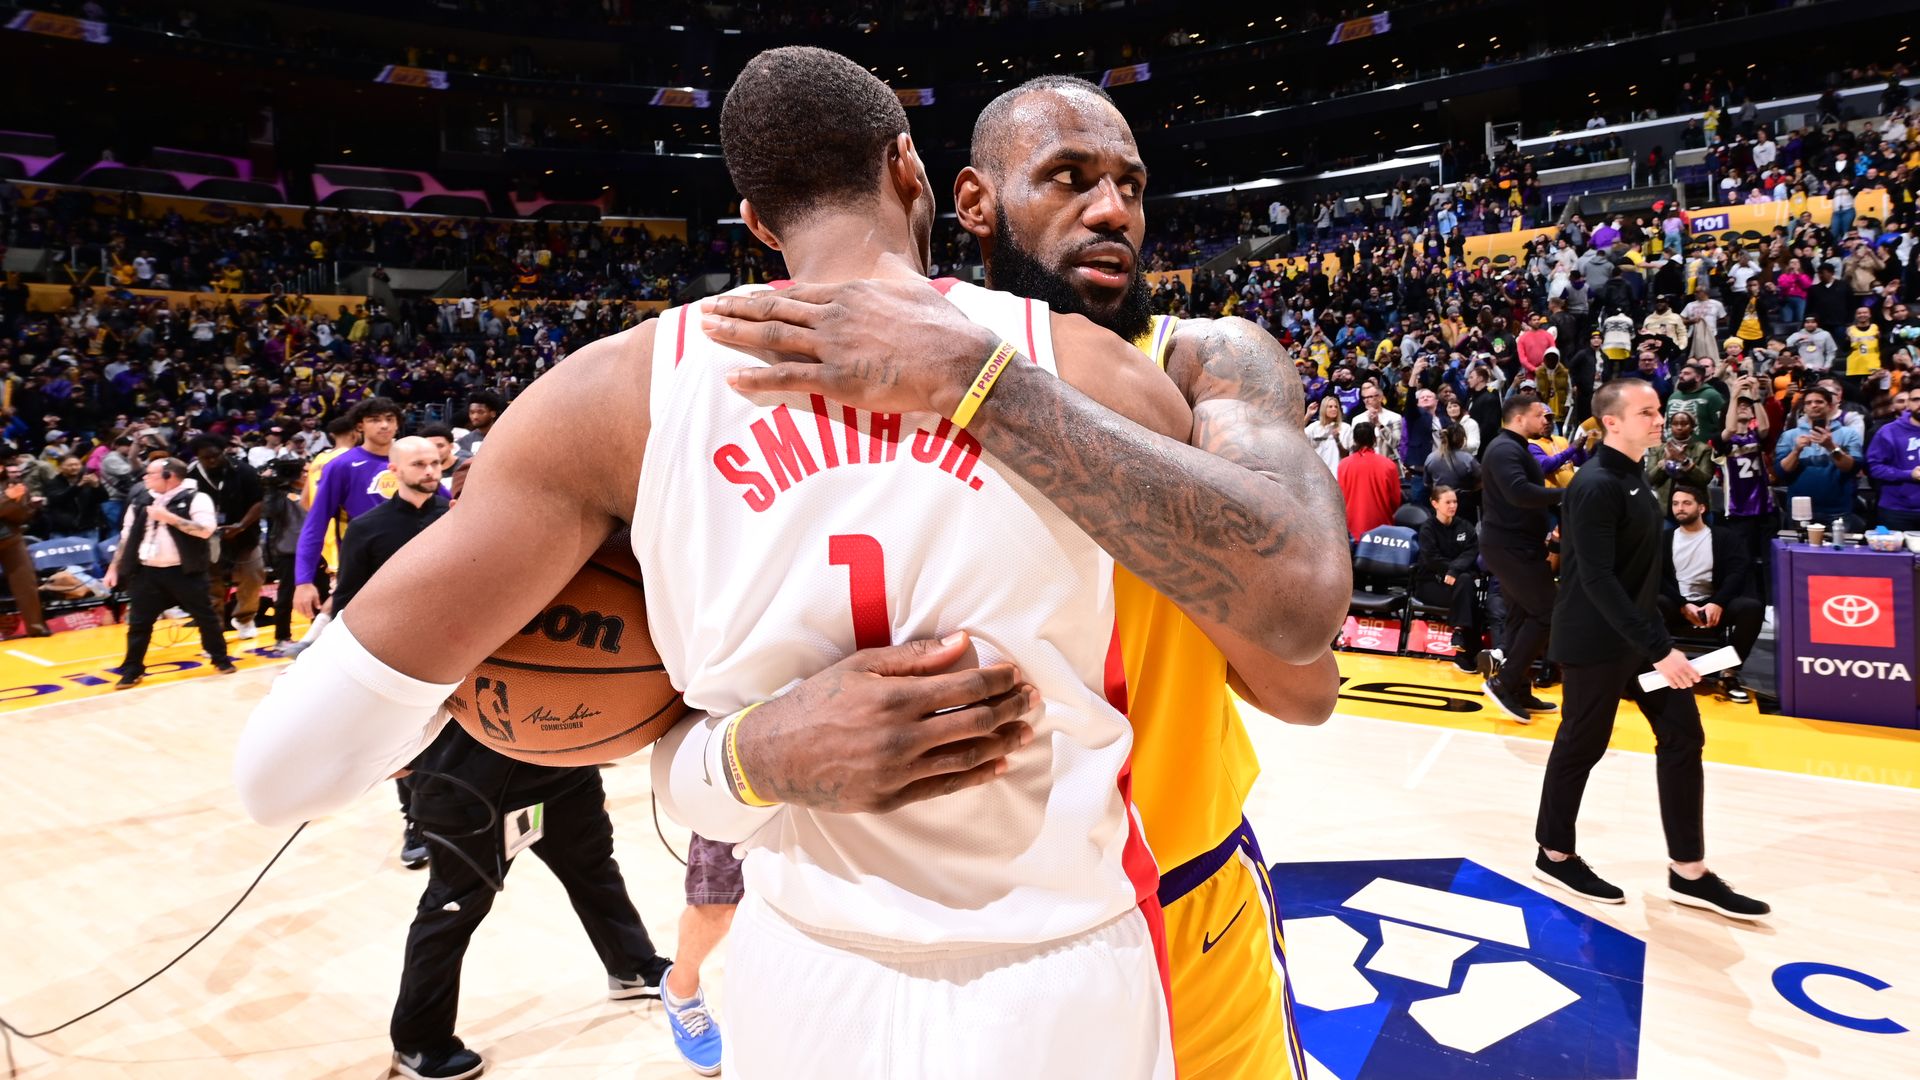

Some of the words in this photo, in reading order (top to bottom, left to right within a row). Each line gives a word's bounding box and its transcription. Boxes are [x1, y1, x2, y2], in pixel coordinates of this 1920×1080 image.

[1695, 215, 1724, 232] 101
[971, 391, 981, 399] I
[1736, 457, 1762, 480] 24
[47, 544, 92, 555] DELTA
[1372, 534, 1410, 549] DELTA
[829, 534, 890, 651] 1
[1797, 656, 1912, 681] TOYOTA
[540, 721, 584, 732] COMMISSIONER
[1772, 962, 1910, 1034] C
